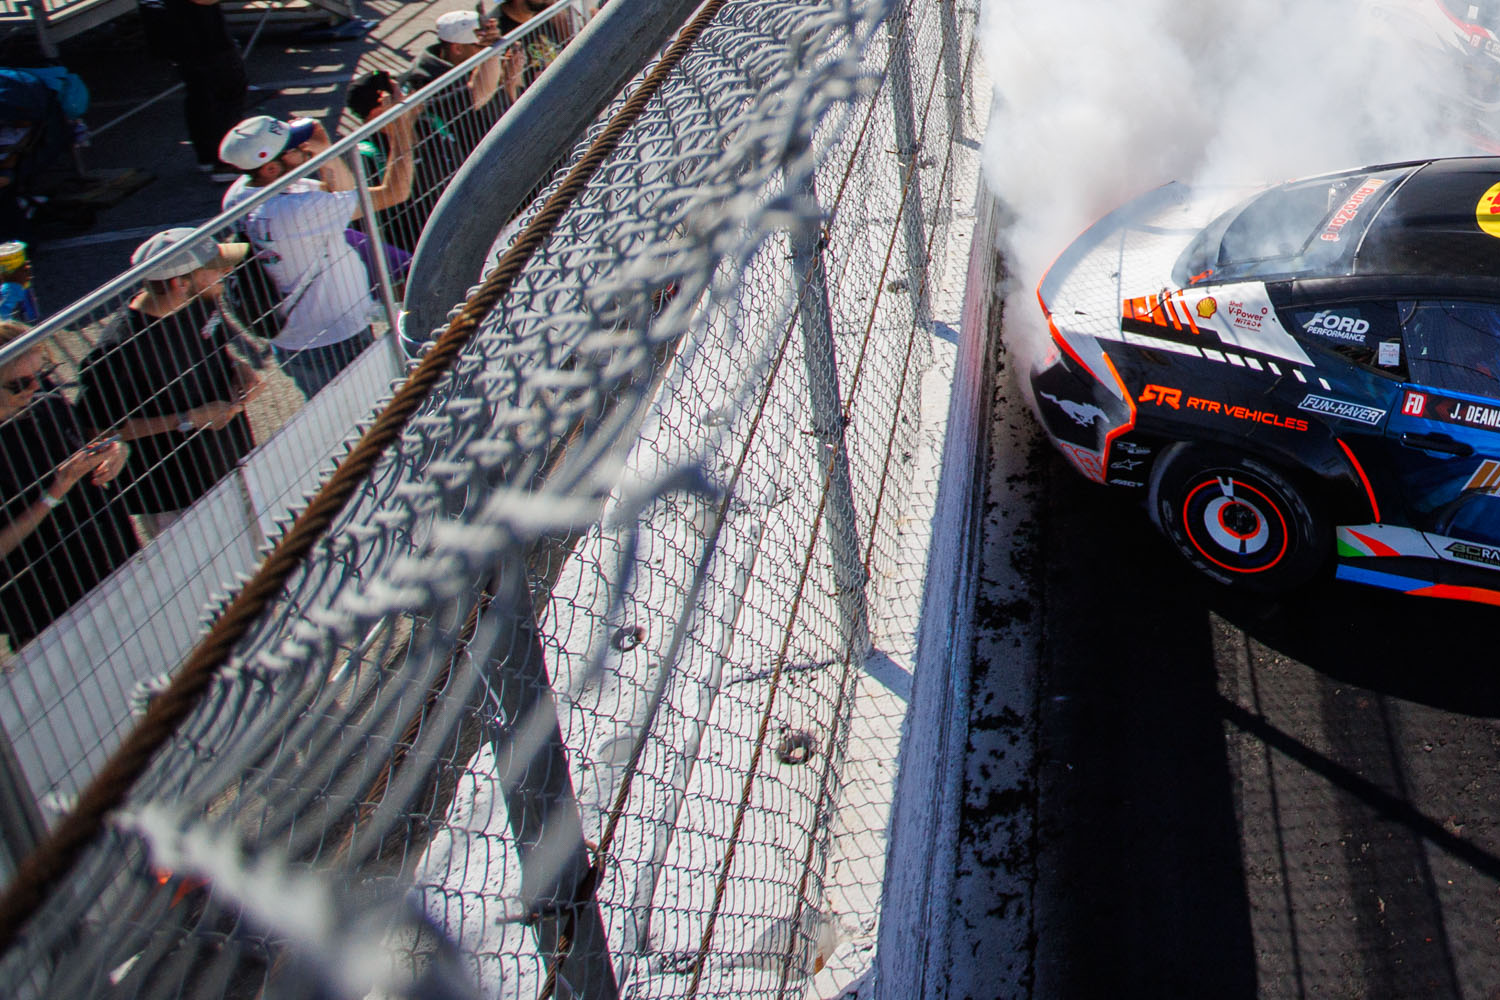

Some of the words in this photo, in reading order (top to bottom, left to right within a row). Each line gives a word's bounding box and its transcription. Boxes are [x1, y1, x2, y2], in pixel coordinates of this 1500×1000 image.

[1321, 187, 1375, 242] AutoZone
[1228, 306, 1264, 322] V-Power
[1308, 312, 1370, 334] FORD
[1306, 326, 1366, 342] PERFORMANCE
[1186, 396, 1222, 415] RTR
[1223, 404, 1309, 432] VEHICLES
[1303, 396, 1379, 423] FUN-HAVER
[1404, 392, 1425, 415] FD
[1450, 402, 1462, 420] J.
